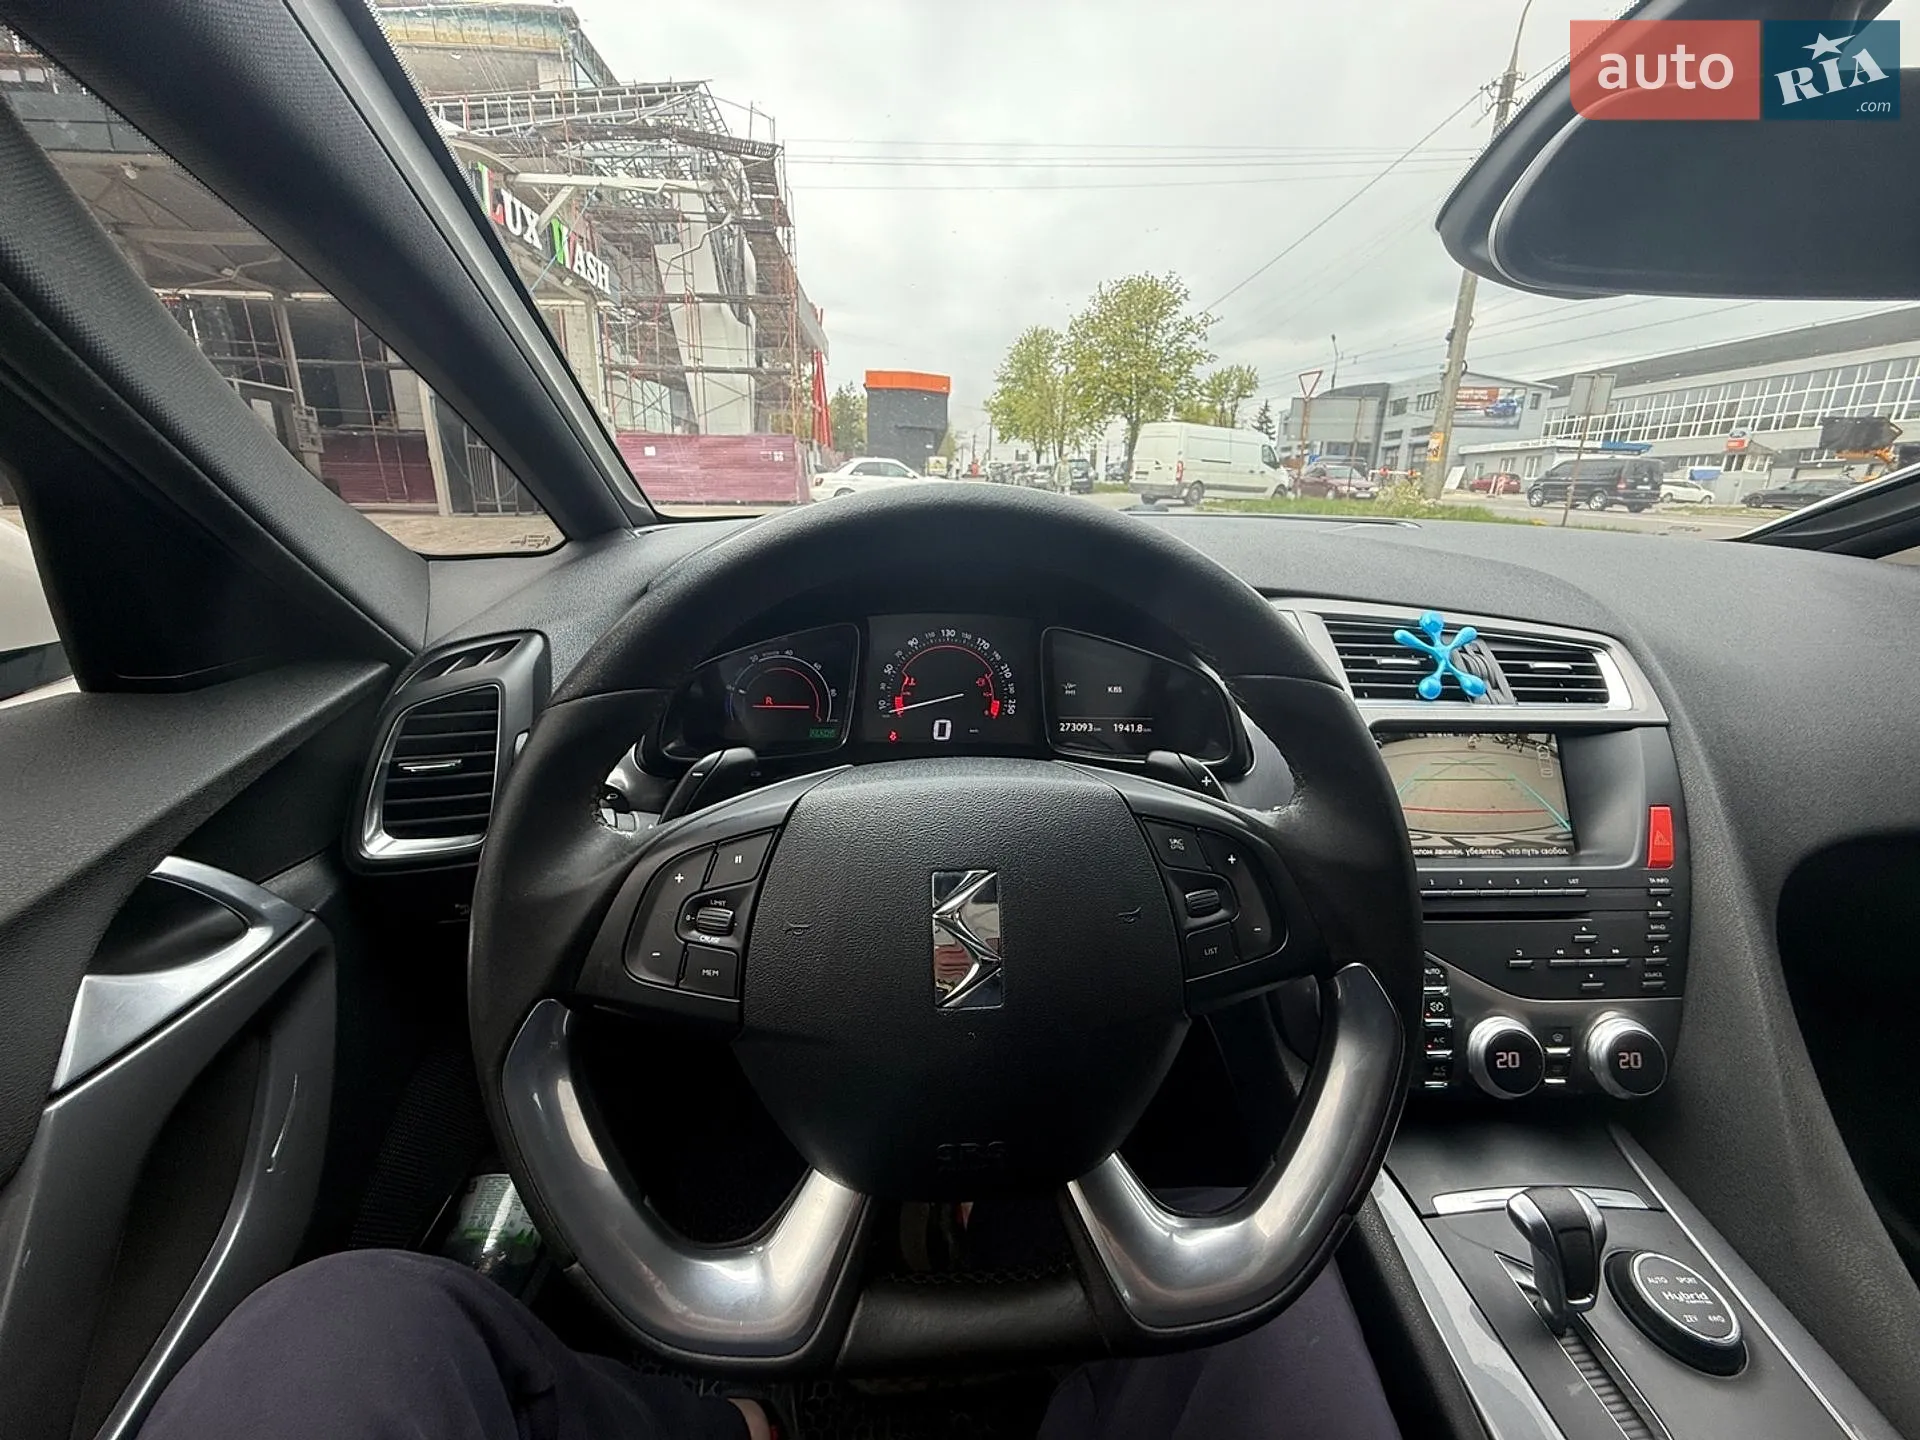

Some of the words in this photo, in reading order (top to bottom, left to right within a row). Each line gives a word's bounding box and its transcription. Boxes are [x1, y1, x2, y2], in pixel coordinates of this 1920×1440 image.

[477, 160, 543, 250] LUX
[550, 216, 612, 295] WASH
[941, 629, 956, 637] 130
[976, 637, 991, 649] 170
[1000, 663, 1013, 679] 210
[933, 719, 952, 740] 0
[1060, 722, 1093, 732] 273093
[1113, 723, 1143, 733] 1941.8
[1204, 947, 1218, 956] LIST
[702, 969, 719, 977] MEM
[1496, 1051, 1520, 1068] 20
[1618, 1051, 1642, 1069] 20
[1661, 1291, 1709, 1302] Hybrid
